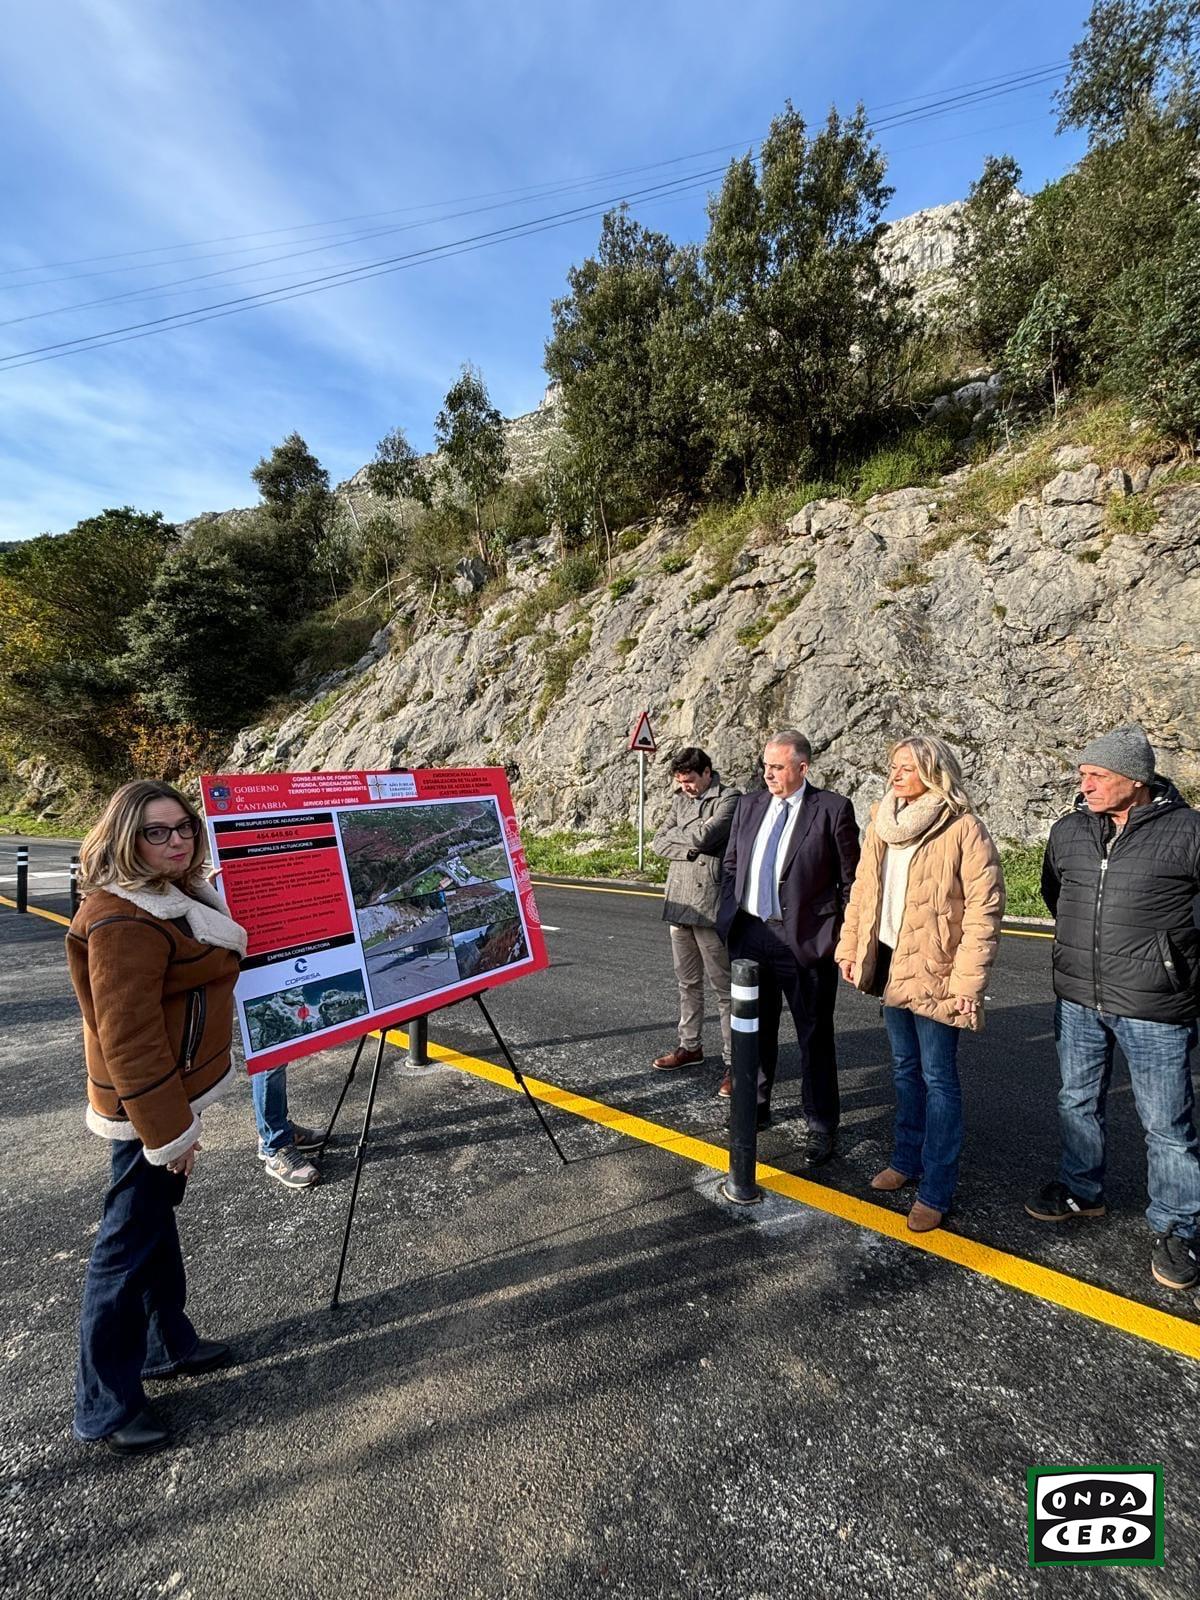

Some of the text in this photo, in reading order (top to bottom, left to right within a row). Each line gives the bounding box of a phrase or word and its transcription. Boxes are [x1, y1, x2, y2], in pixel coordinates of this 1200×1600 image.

[234, 785, 279, 793] GOBIERNO
[237, 802, 287, 811] CANTABRIA
[267, 942, 330, 961] EMPRESA CONSTRUCTORA
[285, 972, 320, 986] COPSESA
